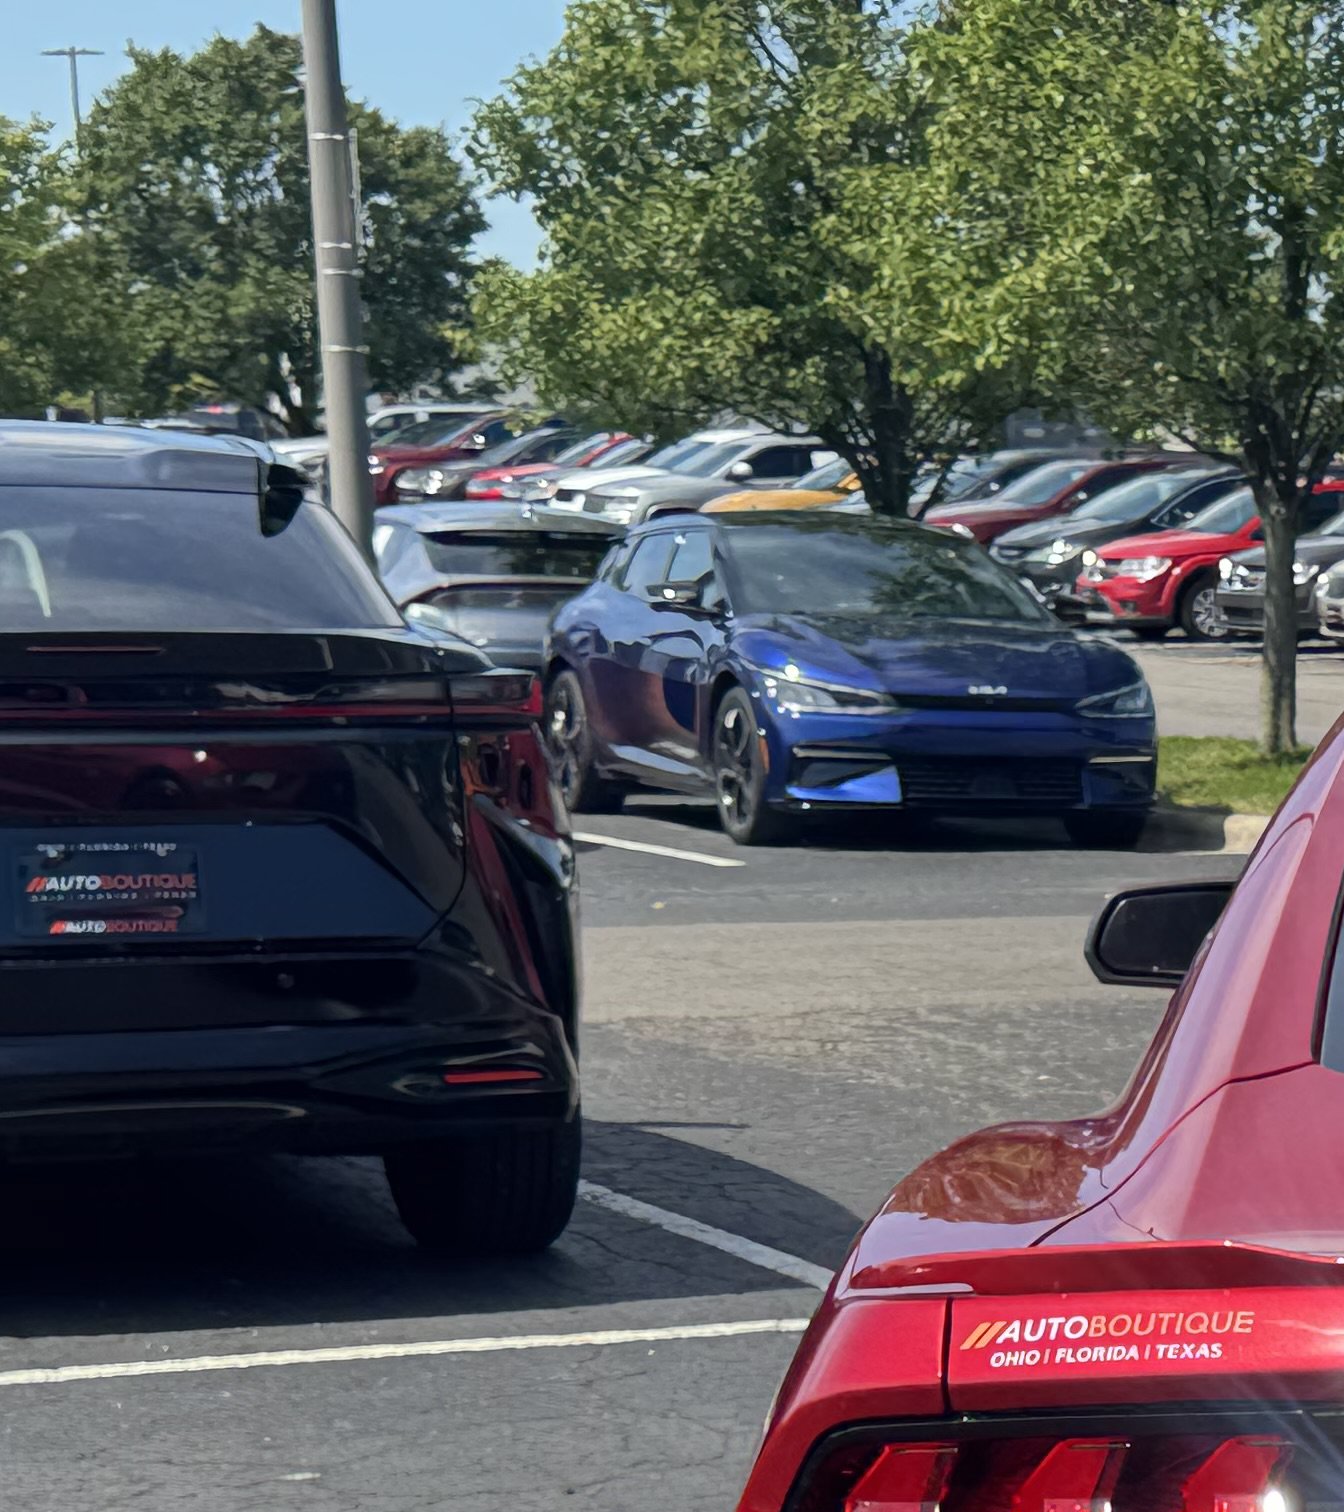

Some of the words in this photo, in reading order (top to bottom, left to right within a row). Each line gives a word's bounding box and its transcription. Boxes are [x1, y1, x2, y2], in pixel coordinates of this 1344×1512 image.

[996, 1311, 1255, 1344] AUTOBOUTIQUE
[990, 1349, 1040, 1368] OHIO
[1054, 1344, 1139, 1363] FLORIDA
[1156, 1342, 1223, 1360] TEXAS
